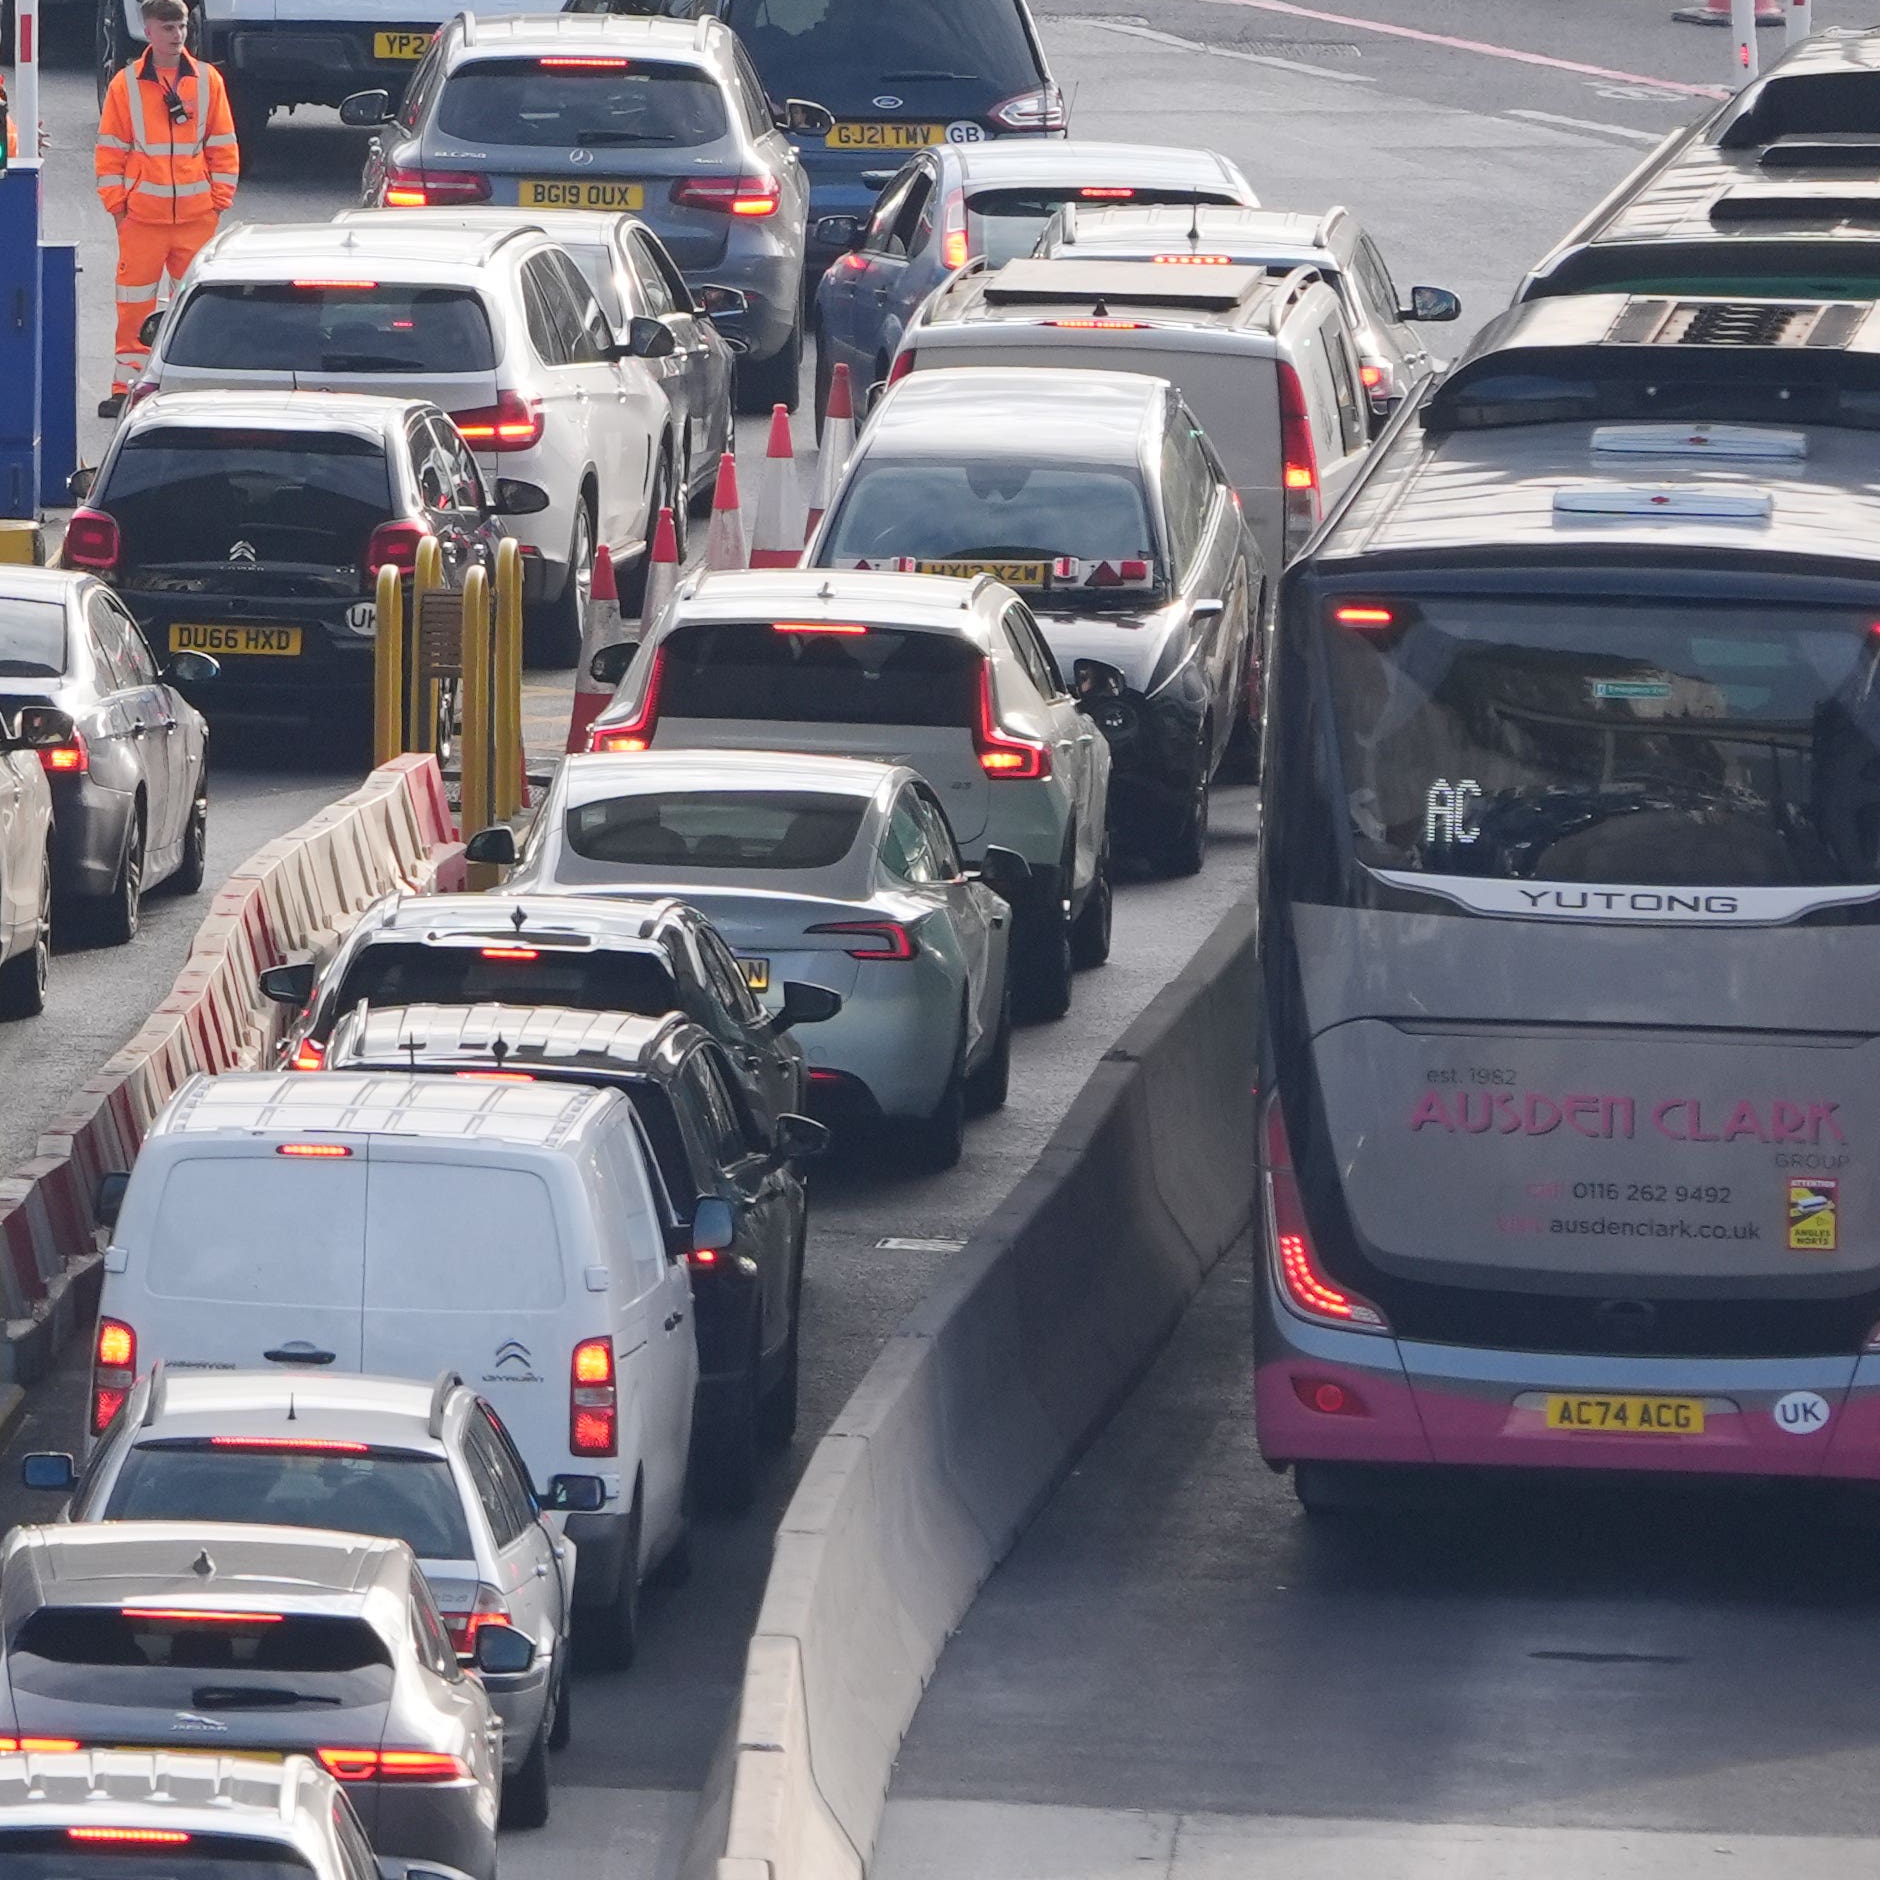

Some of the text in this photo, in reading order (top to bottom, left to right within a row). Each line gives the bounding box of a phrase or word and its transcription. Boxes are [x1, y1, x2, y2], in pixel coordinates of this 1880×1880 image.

[837, 126, 933, 145] GJ21 TMV
[949, 125, 980, 144] GB
[532, 181, 580, 204] BG19
[178, 627, 291, 651] DU66 HXD
[1426, 777, 1482, 843] AC
[1520, 890, 1739, 916] YUTONG
[1426, 1067, 1517, 1086] est. 1982
[1411, 1089, 1848, 1147] AUSDEN CLARK
[1775, 1152, 1850, 1171] GROUP
[1573, 1182, 1619, 1202] 0116
[1627, 1183, 1667, 1203] 262
[1675, 1184, 1732, 1205] 9492
[1549, 1215, 1761, 1242] ausdenclark.co.uk
[1557, 1403, 1692, 1430] AC74 ACG
[1781, 1400, 1822, 1425] UK
